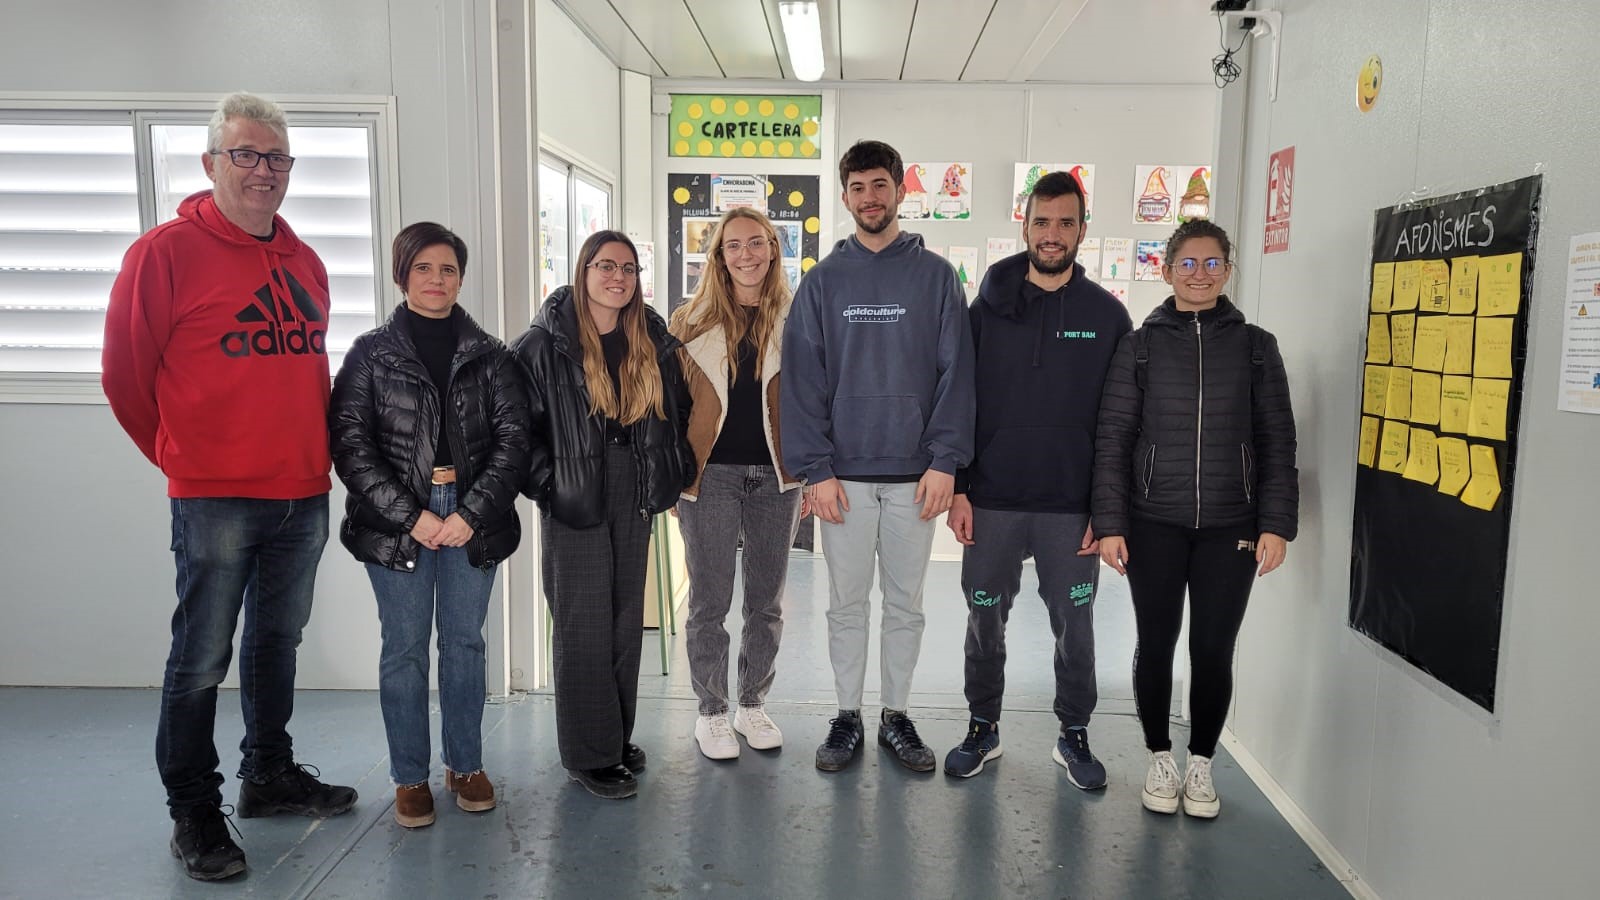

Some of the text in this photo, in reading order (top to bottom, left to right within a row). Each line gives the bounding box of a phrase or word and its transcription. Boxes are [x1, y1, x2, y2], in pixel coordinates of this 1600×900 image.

[701, 121, 801, 139] CARTELERA
[220, 321, 326, 358] adida
[1237, 540, 1257, 551] FIL
